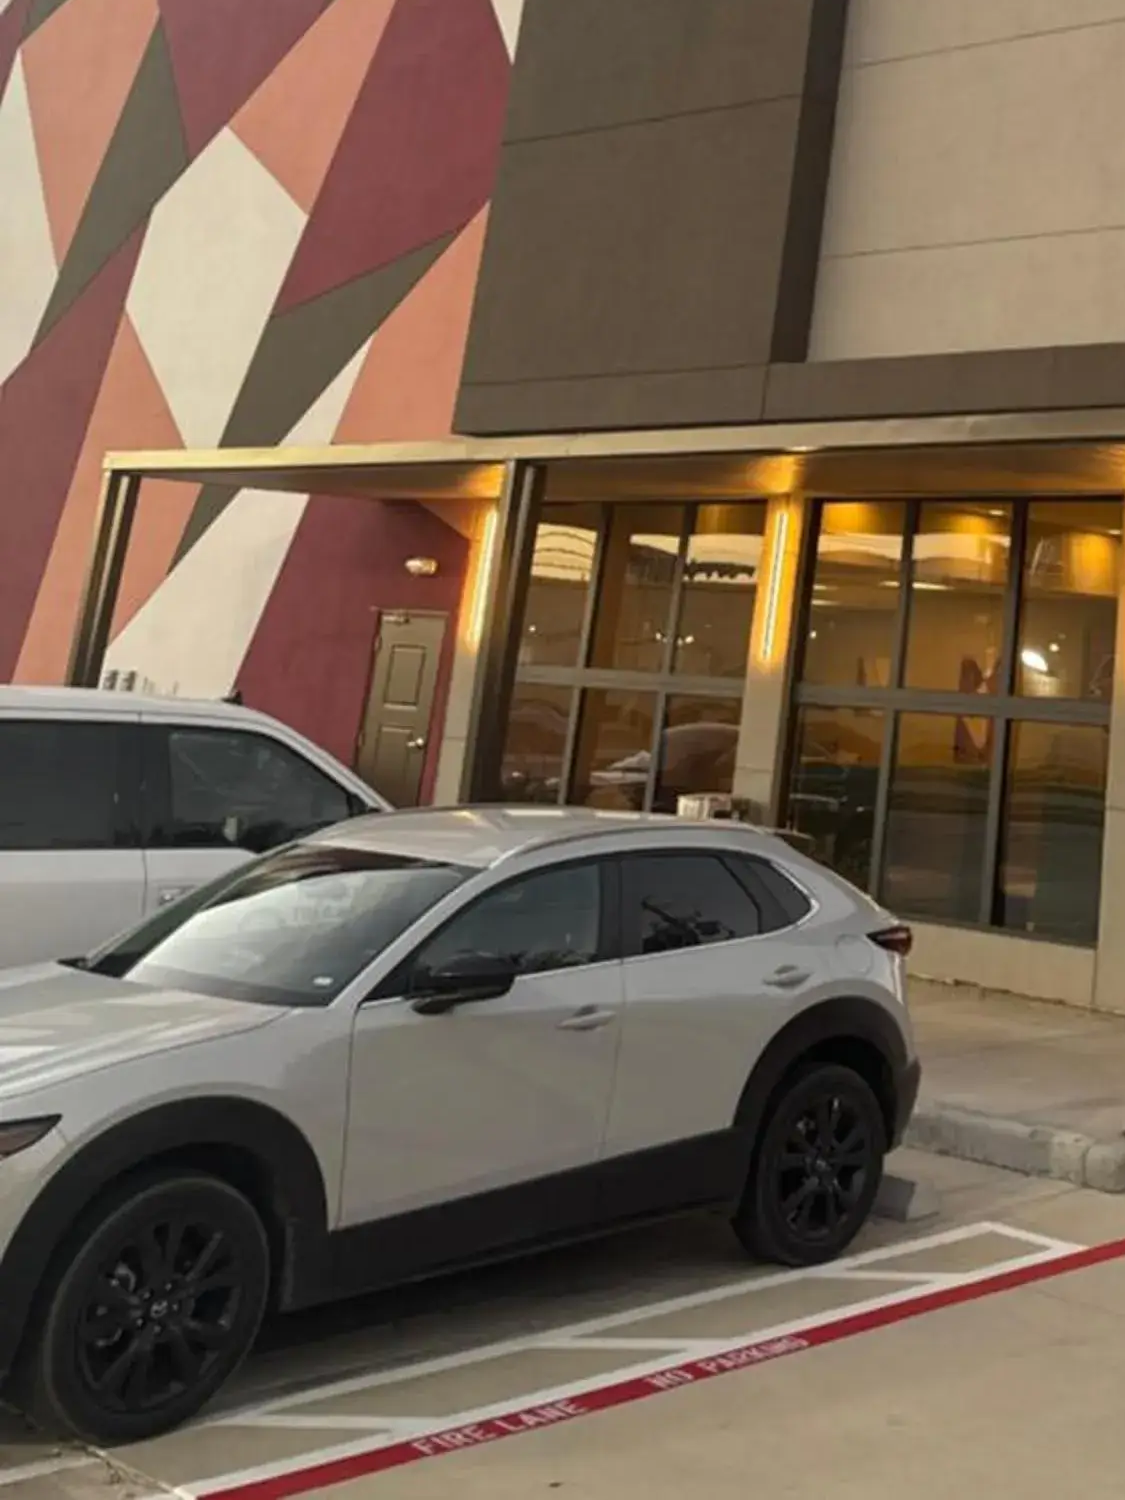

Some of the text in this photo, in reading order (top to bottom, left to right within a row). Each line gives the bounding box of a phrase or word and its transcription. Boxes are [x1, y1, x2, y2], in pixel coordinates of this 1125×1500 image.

[412, 1335, 809, 1455] FIRE LANE NO PARKING
